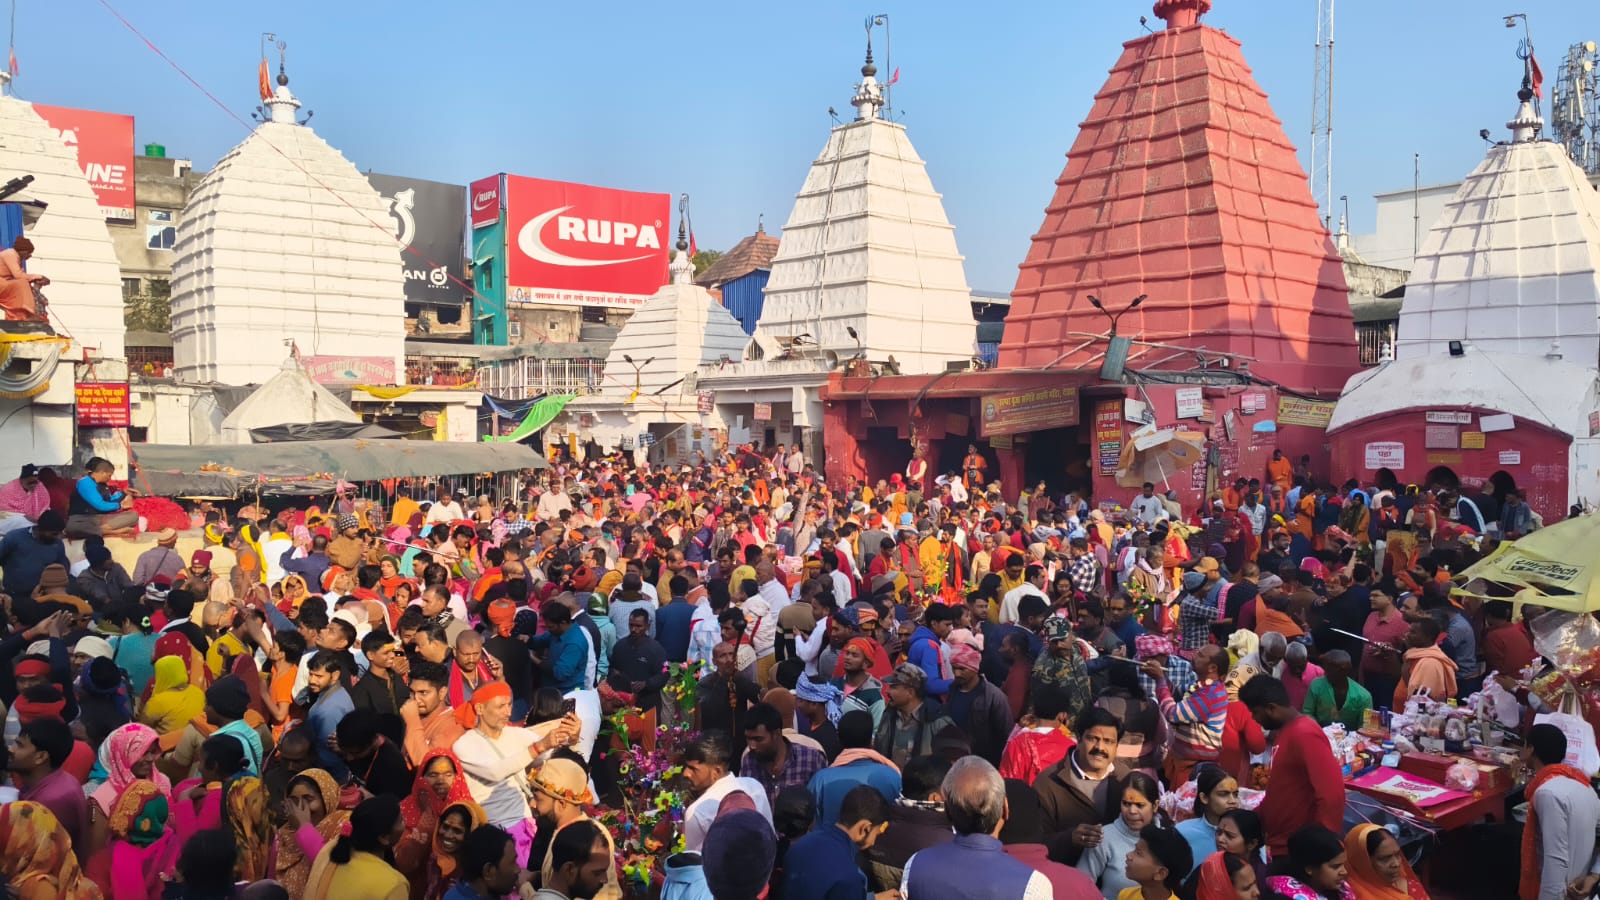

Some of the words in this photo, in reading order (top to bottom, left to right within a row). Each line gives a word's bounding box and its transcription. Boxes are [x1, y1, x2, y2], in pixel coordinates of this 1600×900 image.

[479, 190, 496, 202] RUPA
[558, 215, 661, 249] RUPA
[1515, 559, 1579, 576] UltraTech
